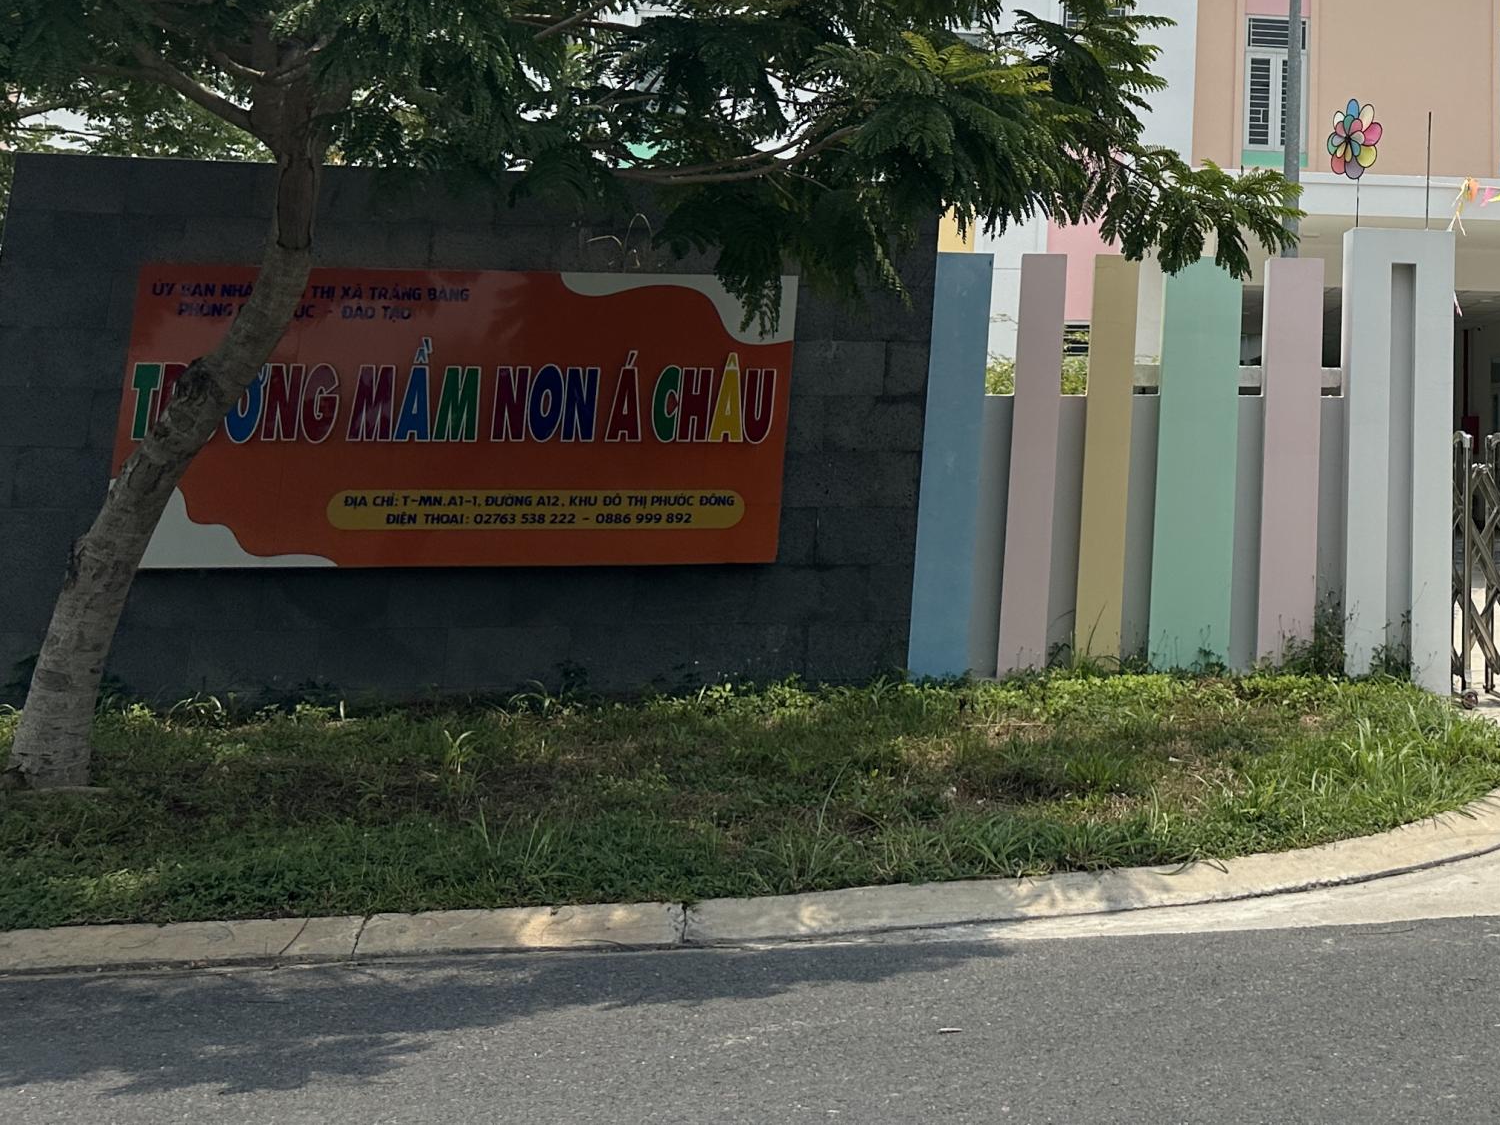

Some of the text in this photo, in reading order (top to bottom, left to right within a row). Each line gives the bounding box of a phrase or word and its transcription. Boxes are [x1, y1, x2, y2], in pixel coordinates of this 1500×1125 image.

[221, 281, 254, 297] NHÂ
[311, 285, 336, 302] THỊ
[341, 283, 363, 300] XÃ
[293, 304, 315, 321] ỤC
[345, 337, 482, 443] MẦM
[490, 363, 600, 443] NON
[603, 349, 642, 443] Á
[651, 351, 777, 444] CHÂU
[344, 495, 368, 509] ĐỊA
[372, 492, 398, 507] CHỈ:
[485, 492, 532, 507] ĐƯỜNG
[569, 495, 598, 506] KHU
[603, 492, 622, 506] ĐÔ
[627, 495, 647, 509] THỊ
[650, 492, 695, 506] PHƯỚC
[386, 511, 417, 526] ĐIỆN
[474, 513, 516, 524] 02763
[521, 513, 546, 524] 538
[550, 513, 576, 524] 222
[595, 513, 631, 524] 0886
[636, 513, 662, 524] 999
[666, 513, 692, 524] 892
